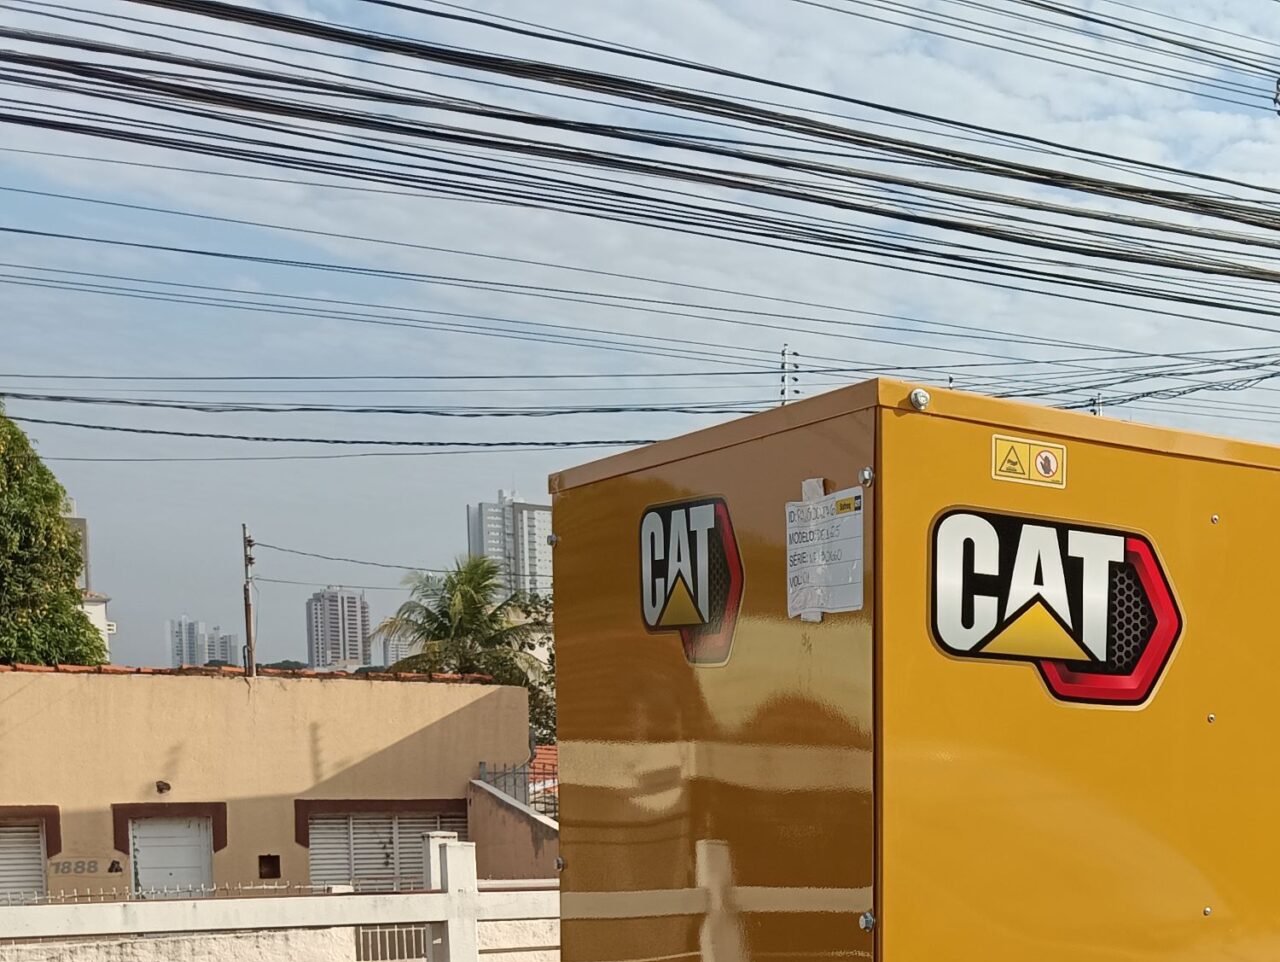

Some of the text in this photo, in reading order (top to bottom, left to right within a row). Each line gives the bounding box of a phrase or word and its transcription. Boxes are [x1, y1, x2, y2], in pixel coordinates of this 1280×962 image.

[641, 503, 715, 626] CAT
[937, 513, 1125, 662] CAT
[50, 860, 98, 874] 1888
